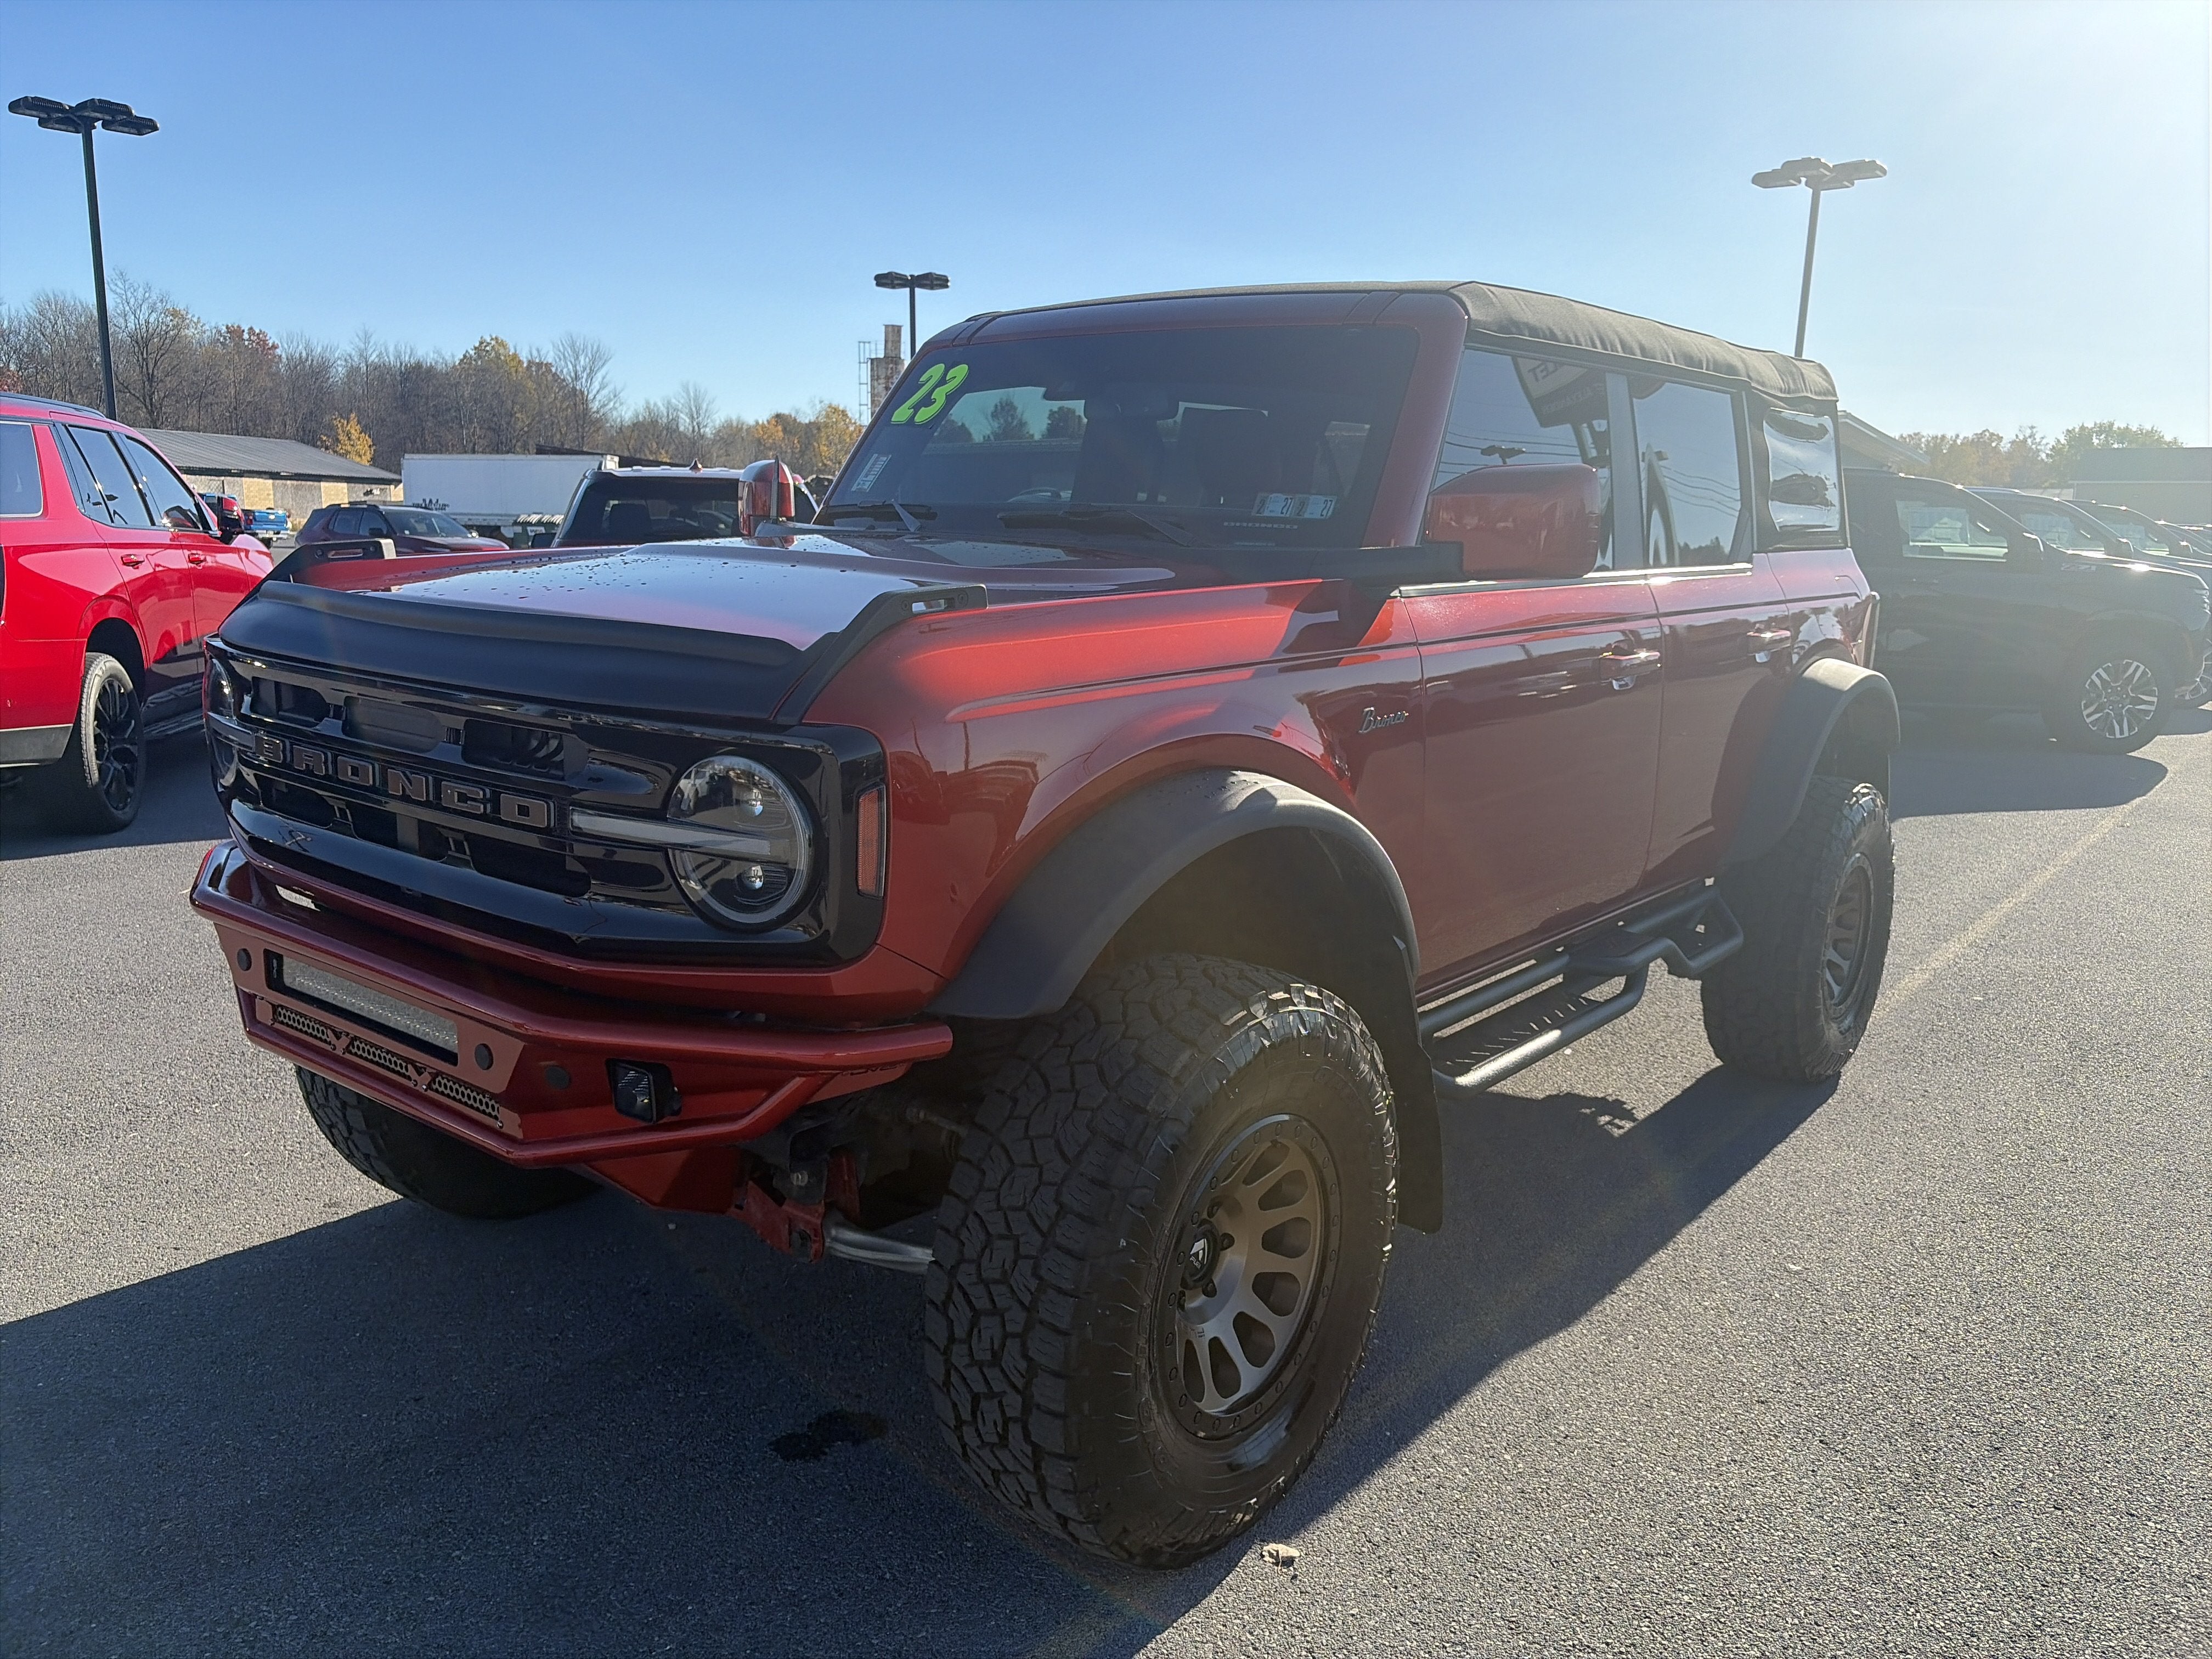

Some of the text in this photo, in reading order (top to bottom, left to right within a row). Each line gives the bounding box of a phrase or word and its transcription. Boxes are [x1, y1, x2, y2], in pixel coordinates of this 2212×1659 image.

[890, 363, 969, 425] 23
[1256, 499, 1265, 515] 2
[1280, 497, 1294, 516] 27
[1296, 501, 1306, 517] 2
[1320, 499, 1334, 517] 27
[1358, 707, 1409, 733] Bronco
[255, 733, 553, 827] BRONCO
